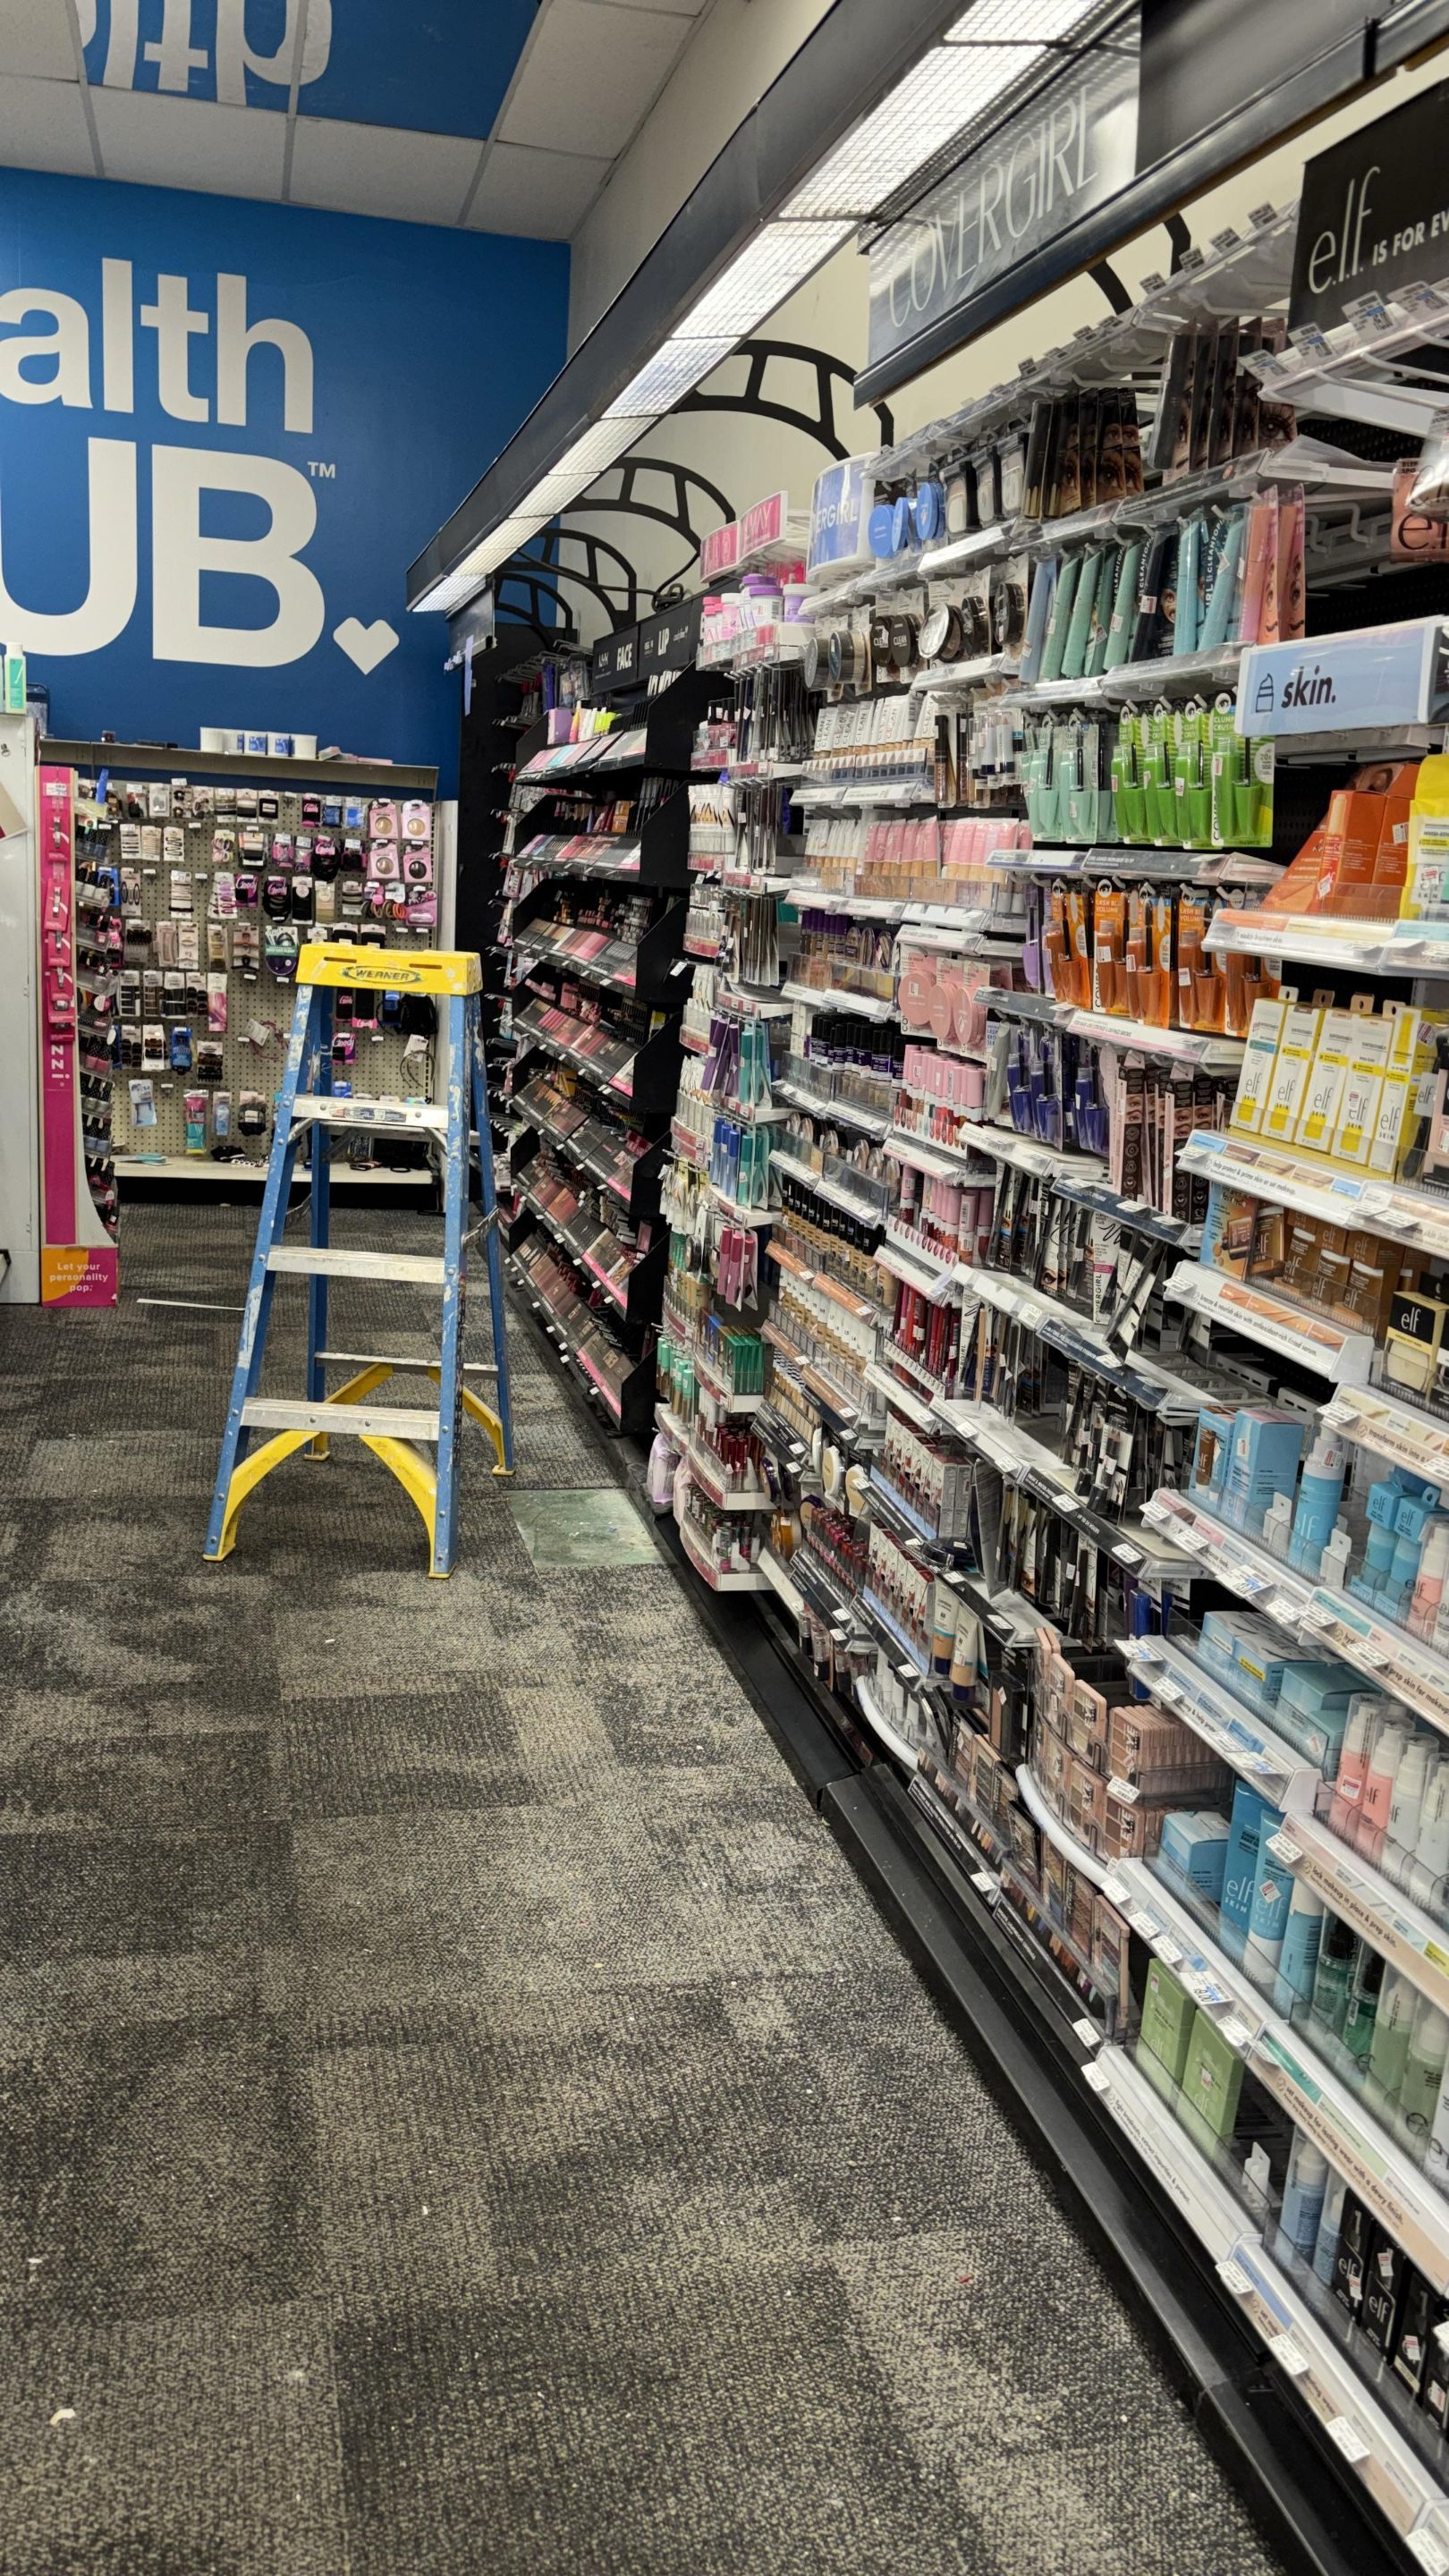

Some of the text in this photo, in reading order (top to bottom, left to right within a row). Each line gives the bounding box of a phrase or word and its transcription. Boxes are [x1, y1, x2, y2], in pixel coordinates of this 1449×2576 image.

[889, 85, 1098, 327] COVERGIRL
[1372, 240, 1387, 266] IS
[1393, 226, 1424, 257] FOR
[1114, 547, 1125, 594] CLEANTOPI
[658, 627, 670, 657] LIP
[894, 635, 907, 646] CLEAN
[616, 643, 633, 672] FACE
[1281, 665, 1336, 709] skin.
[235, 877, 258, 891] Goody
[268, 883, 287, 895] Goody
[356, 969, 410, 981] WERNER
[1244, 1094, 1257, 1102] SKIN
[1275, 1103, 1289, 1111] SKIN
[1347, 1122, 1362, 1131] SKIN
[1379, 1132, 1394, 1141] SKIN
[1253, 1174, 1263, 1183] skin
[57, 1263, 100, 1274] Let your
[50, 1272, 108, 1283] personality
[1368, 1428, 1395, 1447] transform
[1395, 1441, 1408, 1453] skin
[1408, 1447, 1420, 1459] into
[1388, 1667, 1402, 1681] prep
[1403, 1676, 1417, 1689] skin
[1416, 1685, 1426, 1695] for
[1204, 1722, 1216, 1733] prote
[1224, 1897, 1248, 1913] SKIN
[1311, 1867, 1398, 1947] lock makeup in place & prep skin.
[1285, 2087, 1294, 2096] set
[1292, 2095, 1314, 2119] makeup
[1312, 2117, 1322, 2127] for
[1319, 2126, 1340, 2149] lasting
[1338, 2148, 1353, 2164] wear
[1352, 2164, 1367, 2179] with
[1368, 2183, 1387, 2204] dewy
[1385, 2201, 1406, 2224] finish.
